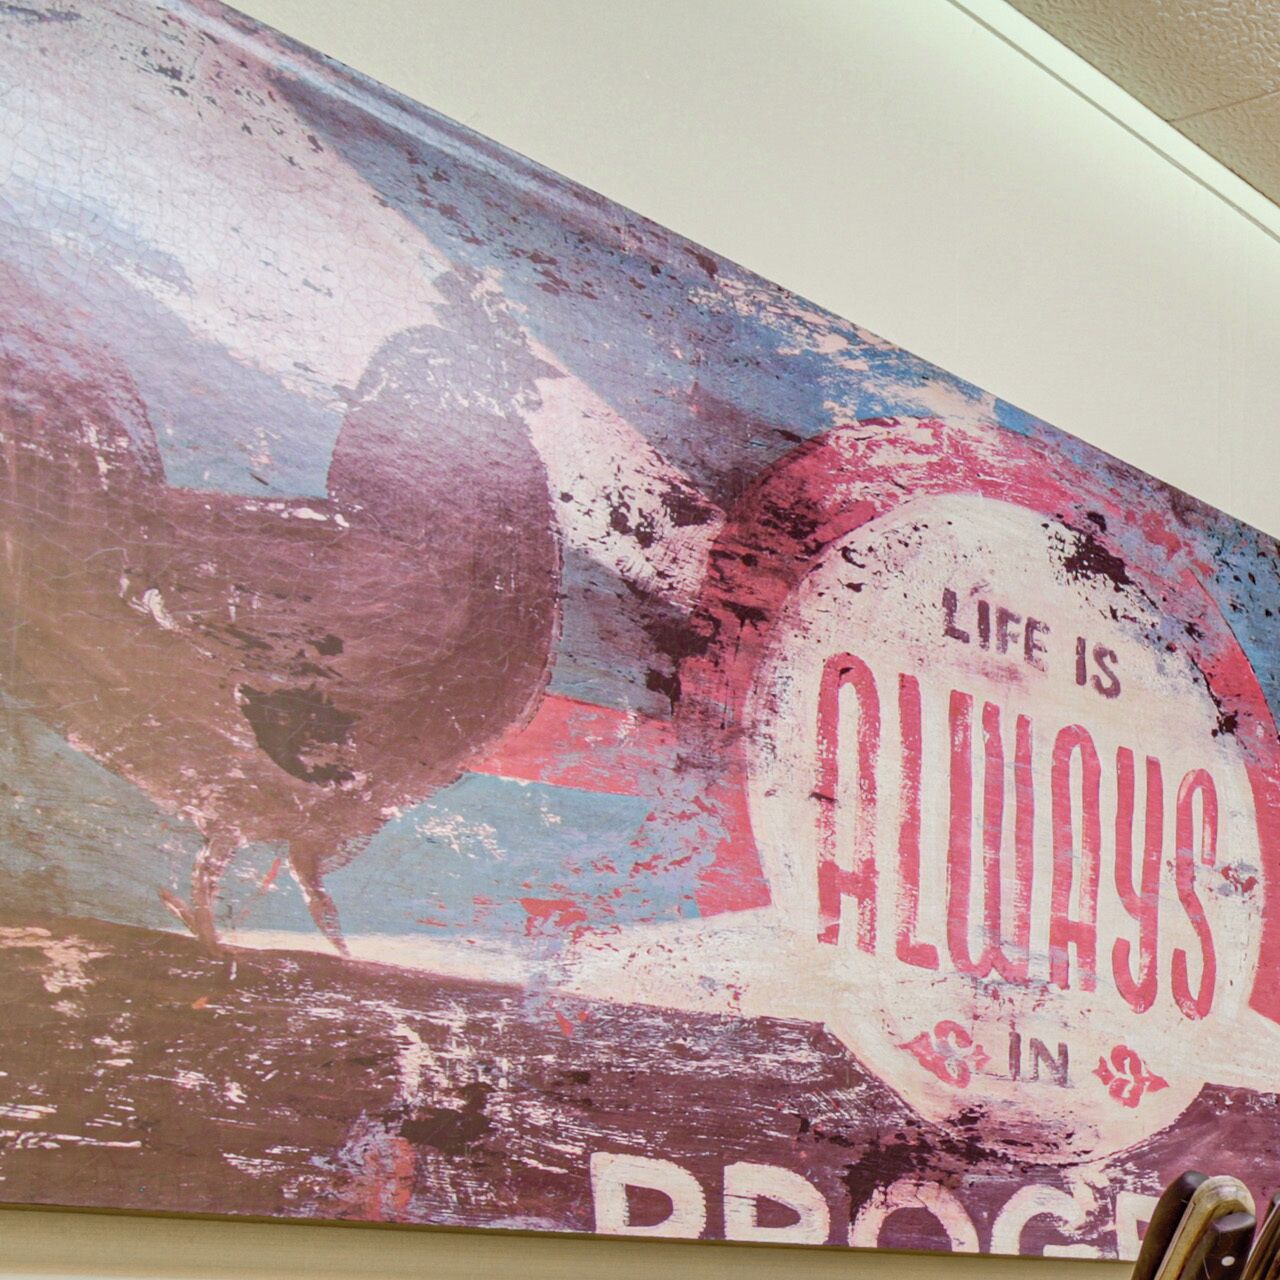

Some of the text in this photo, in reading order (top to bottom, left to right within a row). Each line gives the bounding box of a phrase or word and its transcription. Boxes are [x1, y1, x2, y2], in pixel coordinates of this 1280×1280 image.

[942, 587, 1121, 699] LIFE IS
[815, 651, 1218, 1022] ALWAYS
[1009, 1021, 1070, 1086] IN
